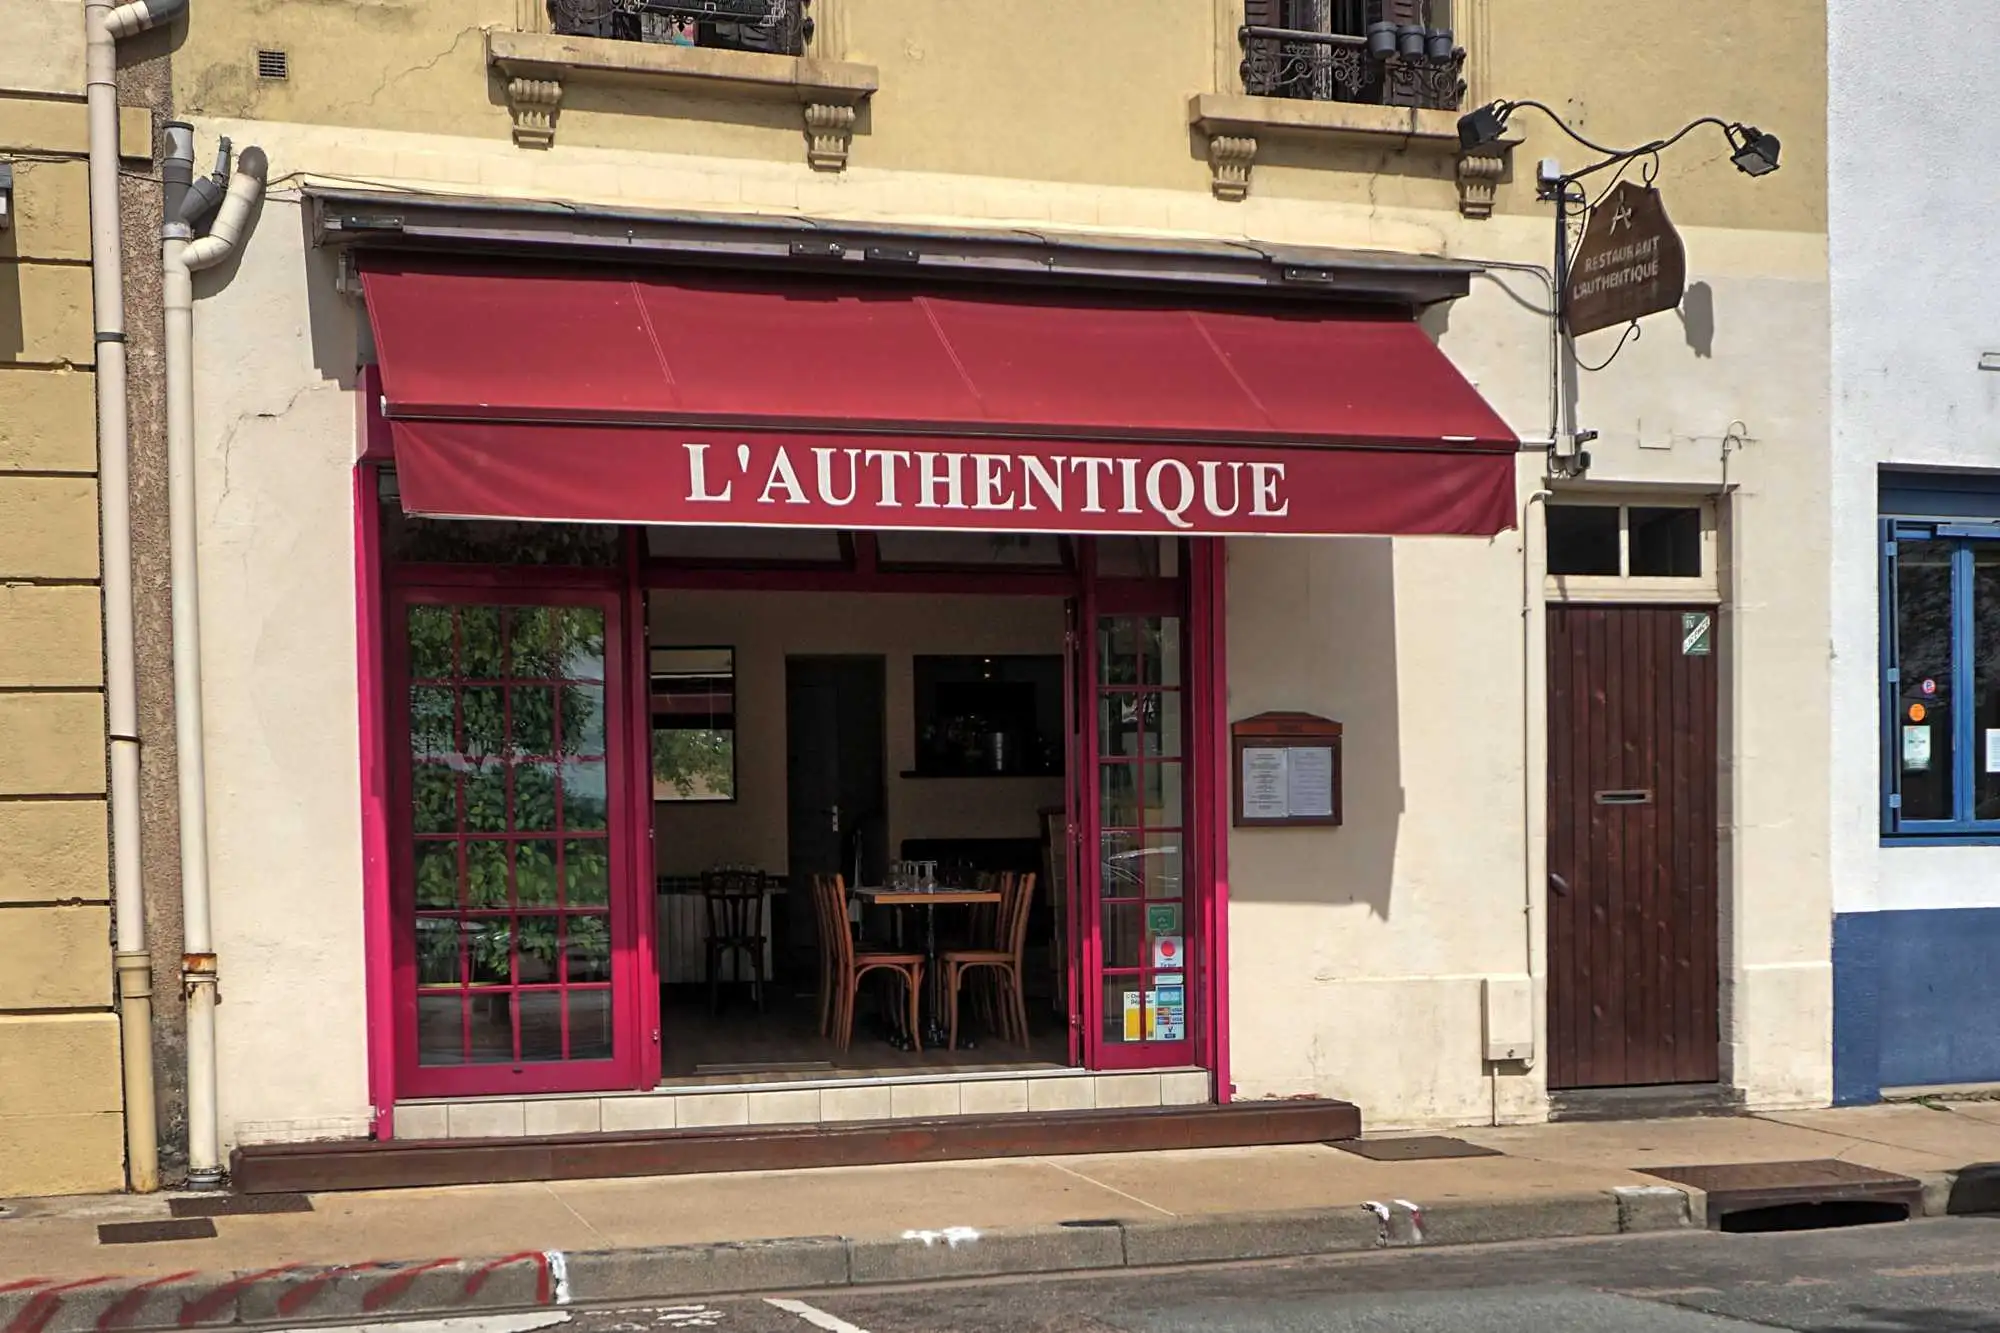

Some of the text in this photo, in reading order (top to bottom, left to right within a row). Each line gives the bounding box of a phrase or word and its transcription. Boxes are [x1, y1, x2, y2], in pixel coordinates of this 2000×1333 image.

[1585, 235, 1660, 273] RESTAURANT
[1573, 260, 1659, 300] L'AUTHENTIQUE
[682, 443, 1289, 528] L'AUTHENTIQUE
